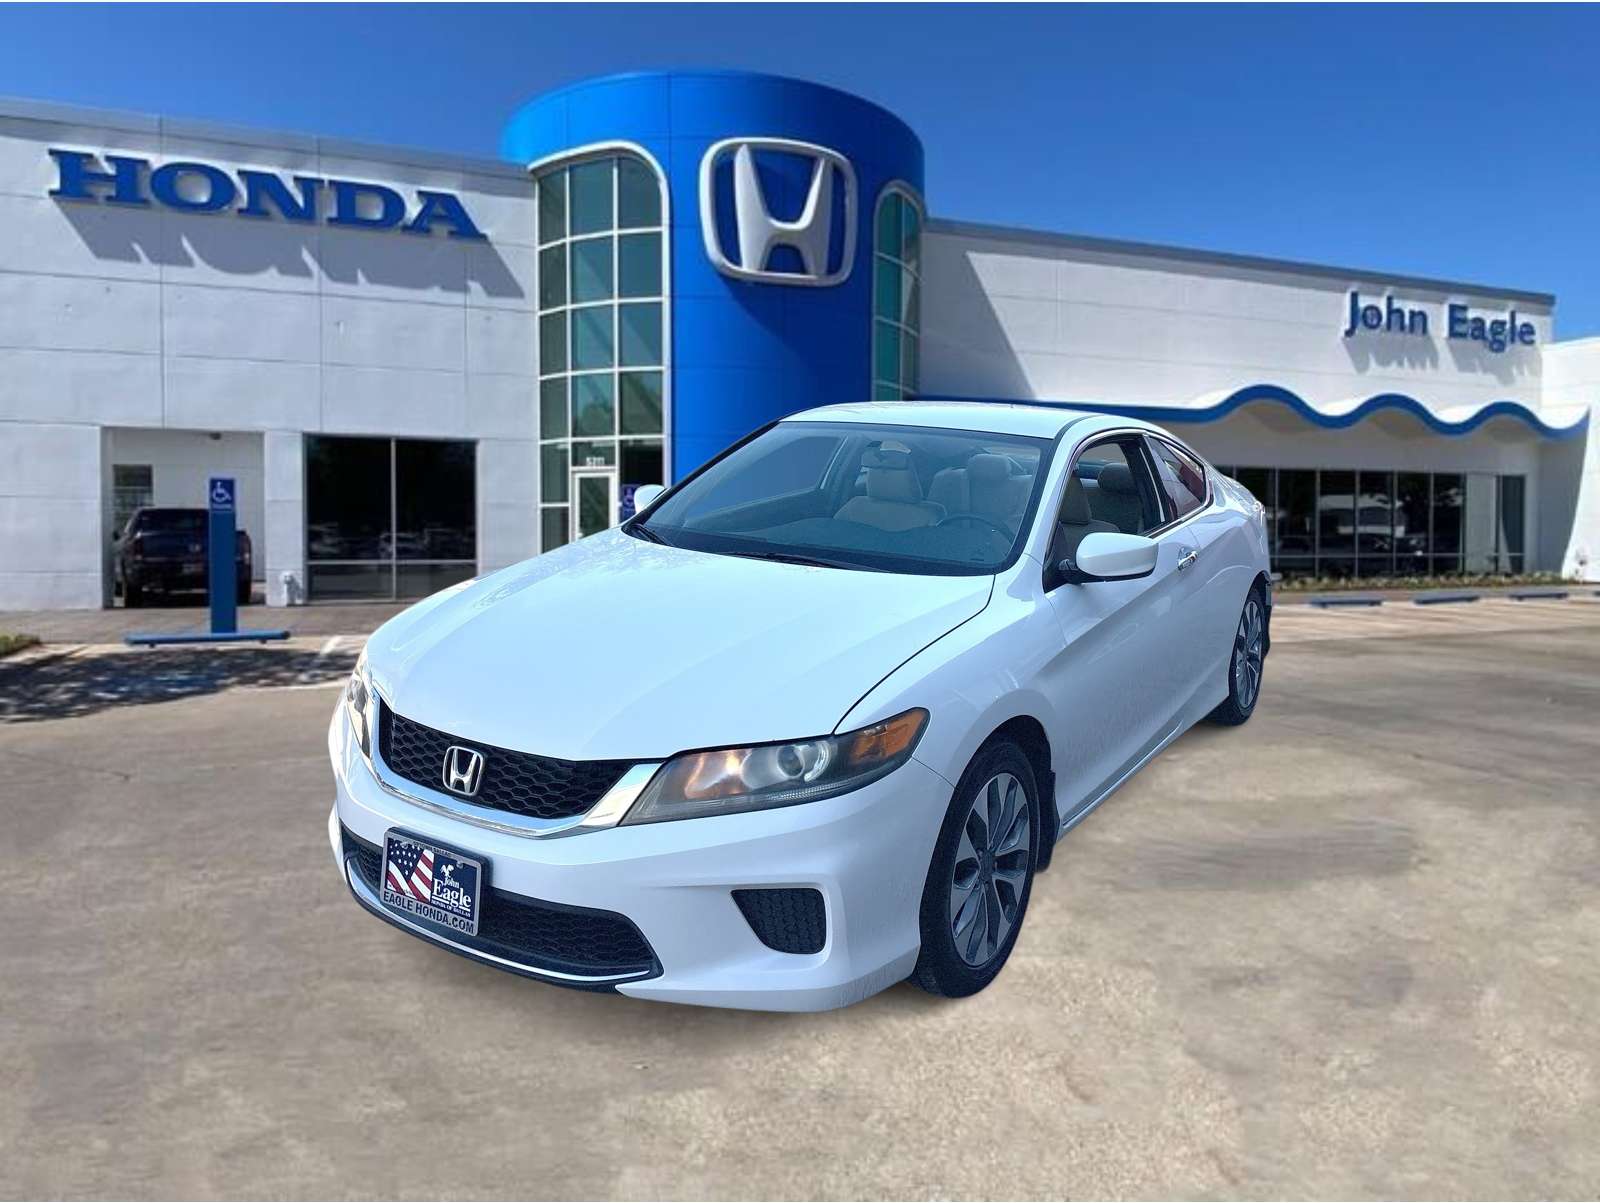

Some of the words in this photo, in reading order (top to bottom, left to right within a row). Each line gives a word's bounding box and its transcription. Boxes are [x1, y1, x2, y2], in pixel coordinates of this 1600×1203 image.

[48, 148, 488, 241] HONDA
[1344, 291, 1428, 338] John
[1448, 303, 1536, 353] Eagle
[432, 877, 472, 908] Eagle
[443, 877, 460, 889] John
[383, 890, 413, 912] EAGLE
[415, 903, 474, 933] HONDA.COM
